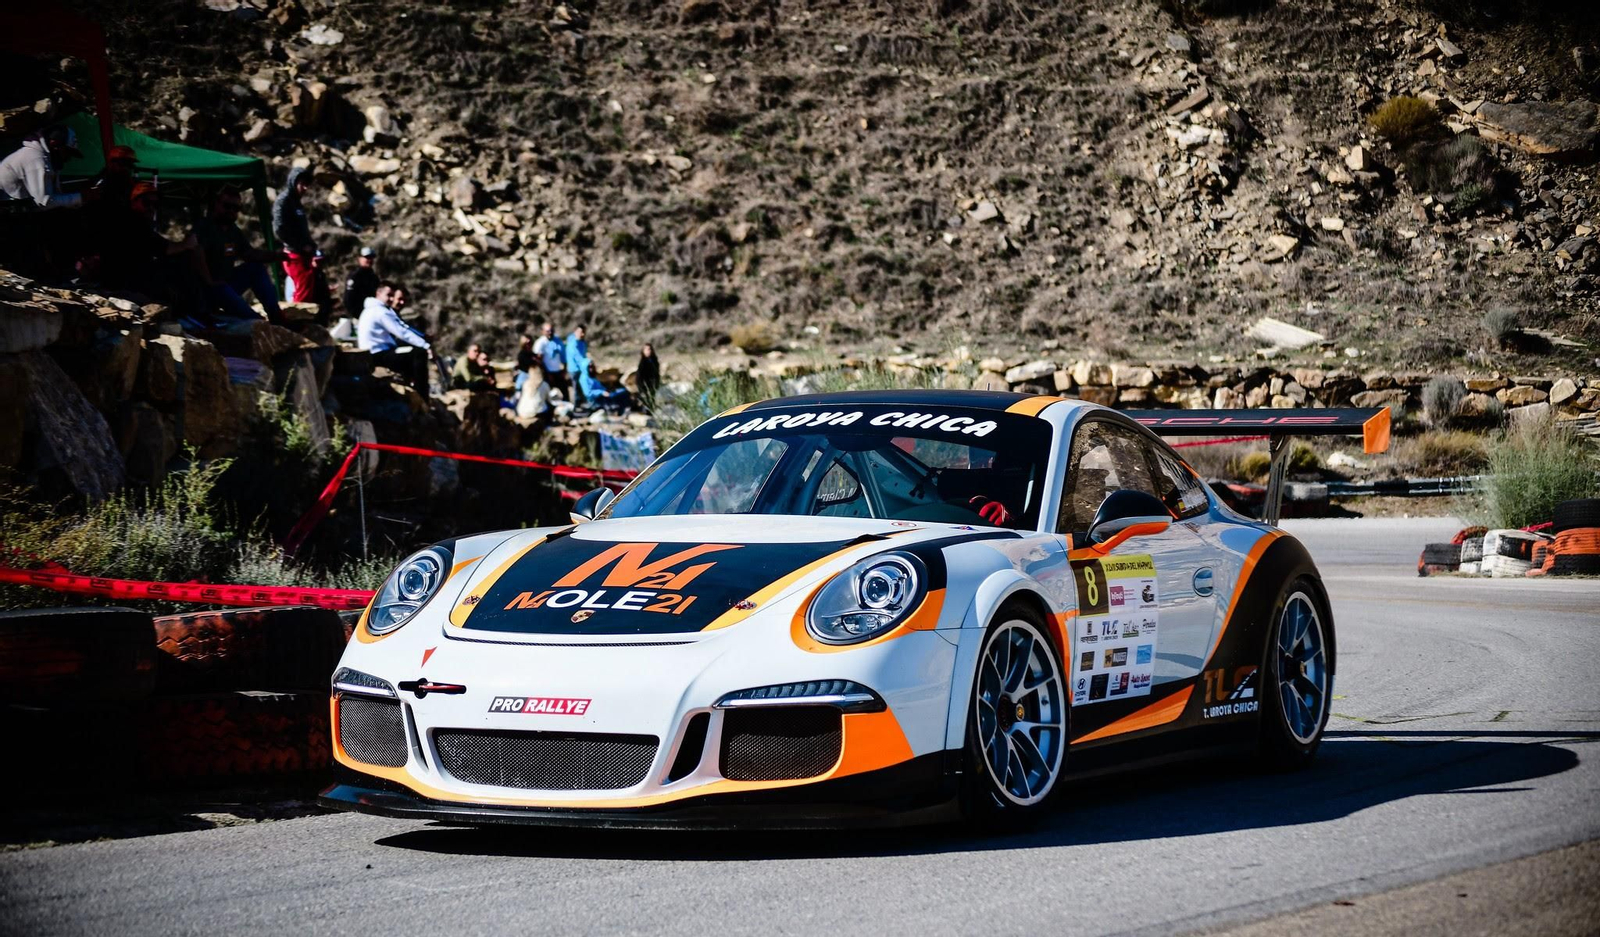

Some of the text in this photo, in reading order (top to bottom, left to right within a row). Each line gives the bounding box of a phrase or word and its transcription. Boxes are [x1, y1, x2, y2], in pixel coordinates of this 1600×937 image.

[712, 411, 999, 440] LAROYA CHICA
[1084, 566, 1099, 607] 8
[491, 699, 589, 714] PRO RALLYE
[1233, 701, 1259, 714] CHICA
